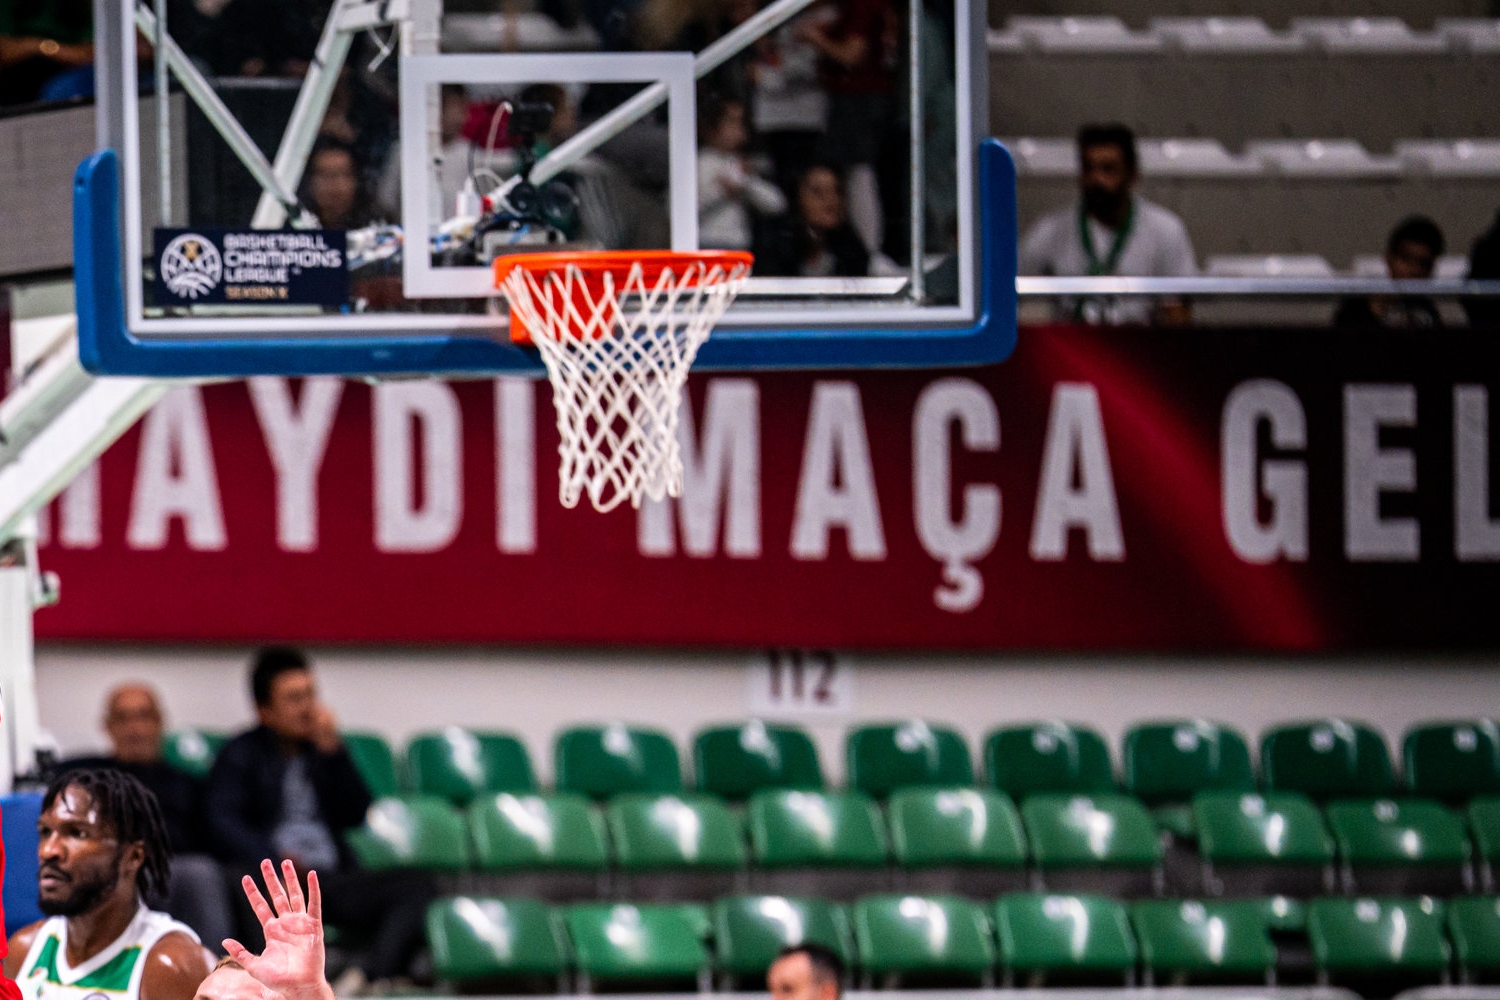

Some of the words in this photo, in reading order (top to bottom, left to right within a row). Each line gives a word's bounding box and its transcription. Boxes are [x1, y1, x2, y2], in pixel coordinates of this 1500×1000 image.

[223, 233, 330, 250] BASKETBALL
[223, 249, 342, 268] CHAMPIONS
[223, 267, 289, 283] LEAGUE
[636, 376, 1127, 613] MAÇA
[1220, 376, 1500, 564] GEL
